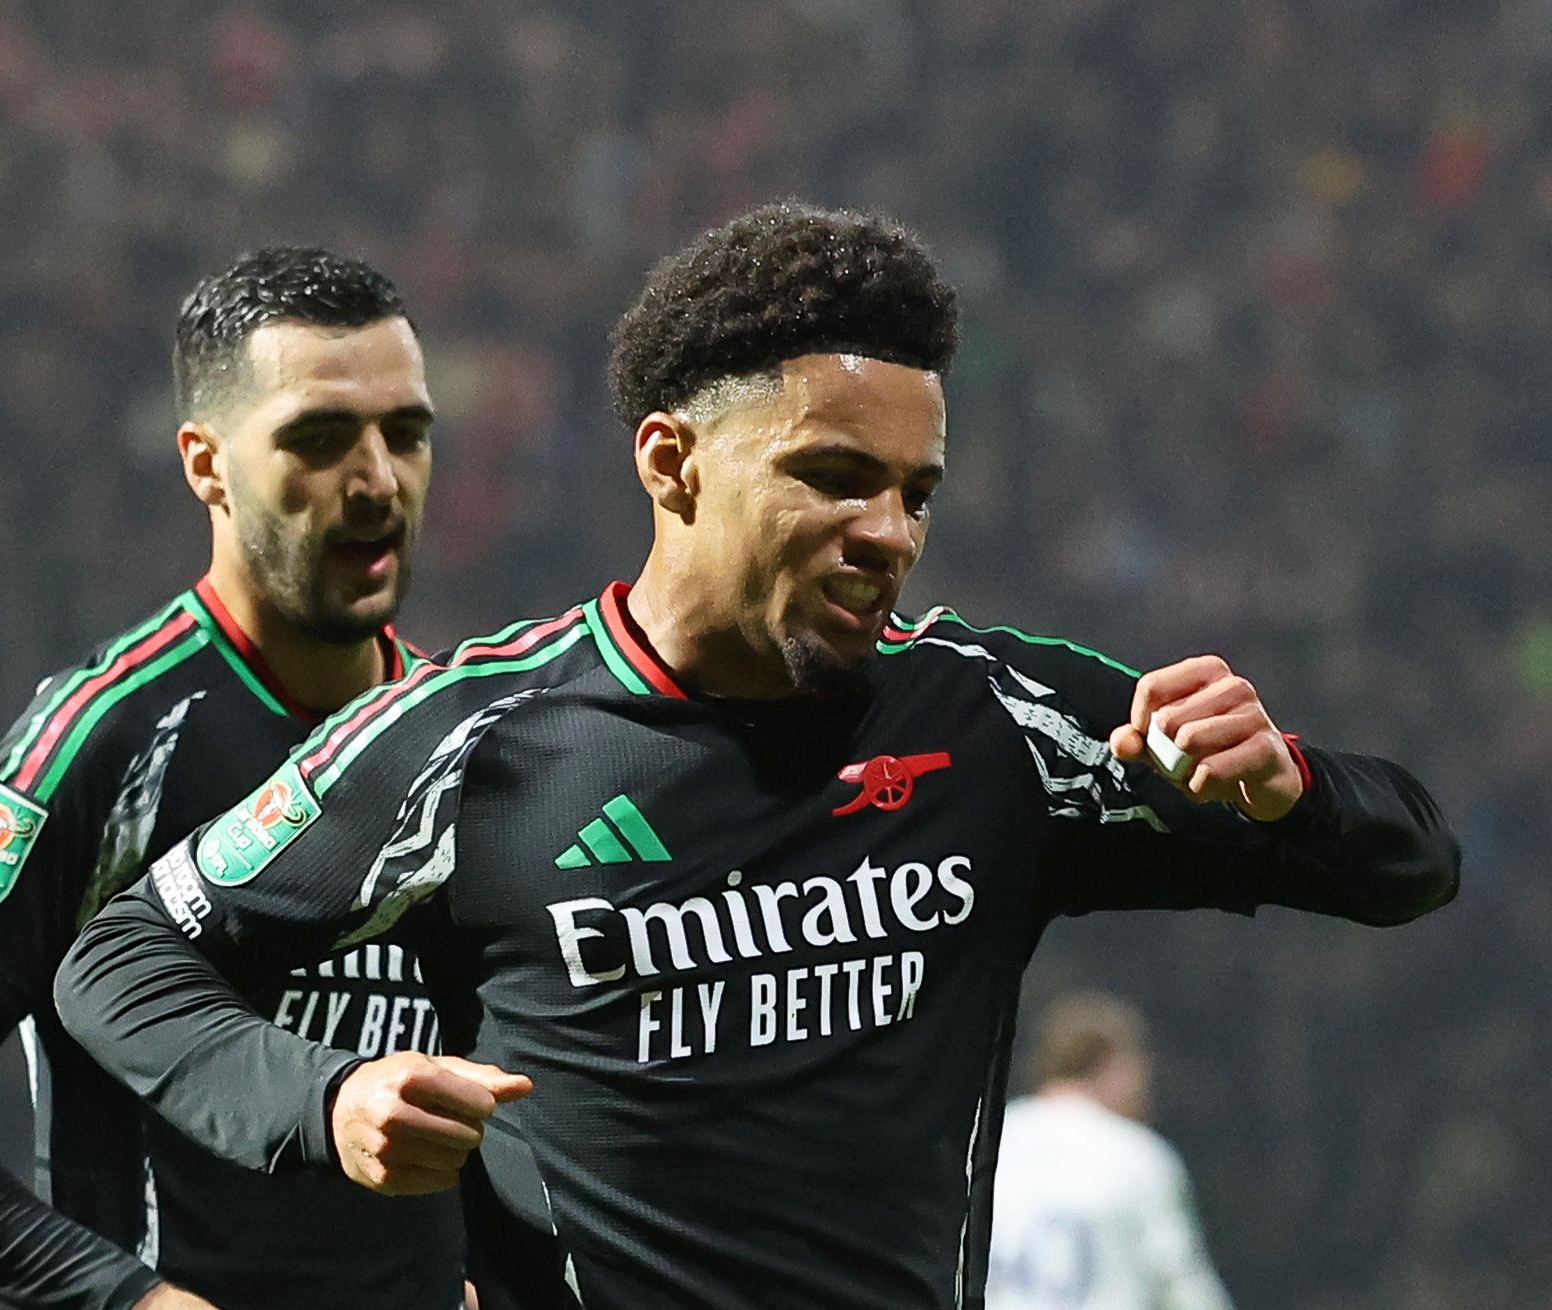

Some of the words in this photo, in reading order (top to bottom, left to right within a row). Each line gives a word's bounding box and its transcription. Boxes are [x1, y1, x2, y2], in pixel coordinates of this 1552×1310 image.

[156, 872, 202, 940] racism
[173, 861, 212, 919] room
[546, 855, 975, 988] Emirates
[357, 993, 443, 1058] BETT
[637, 980, 726, 1064] FLY
[749, 951, 925, 1048] BETTER
